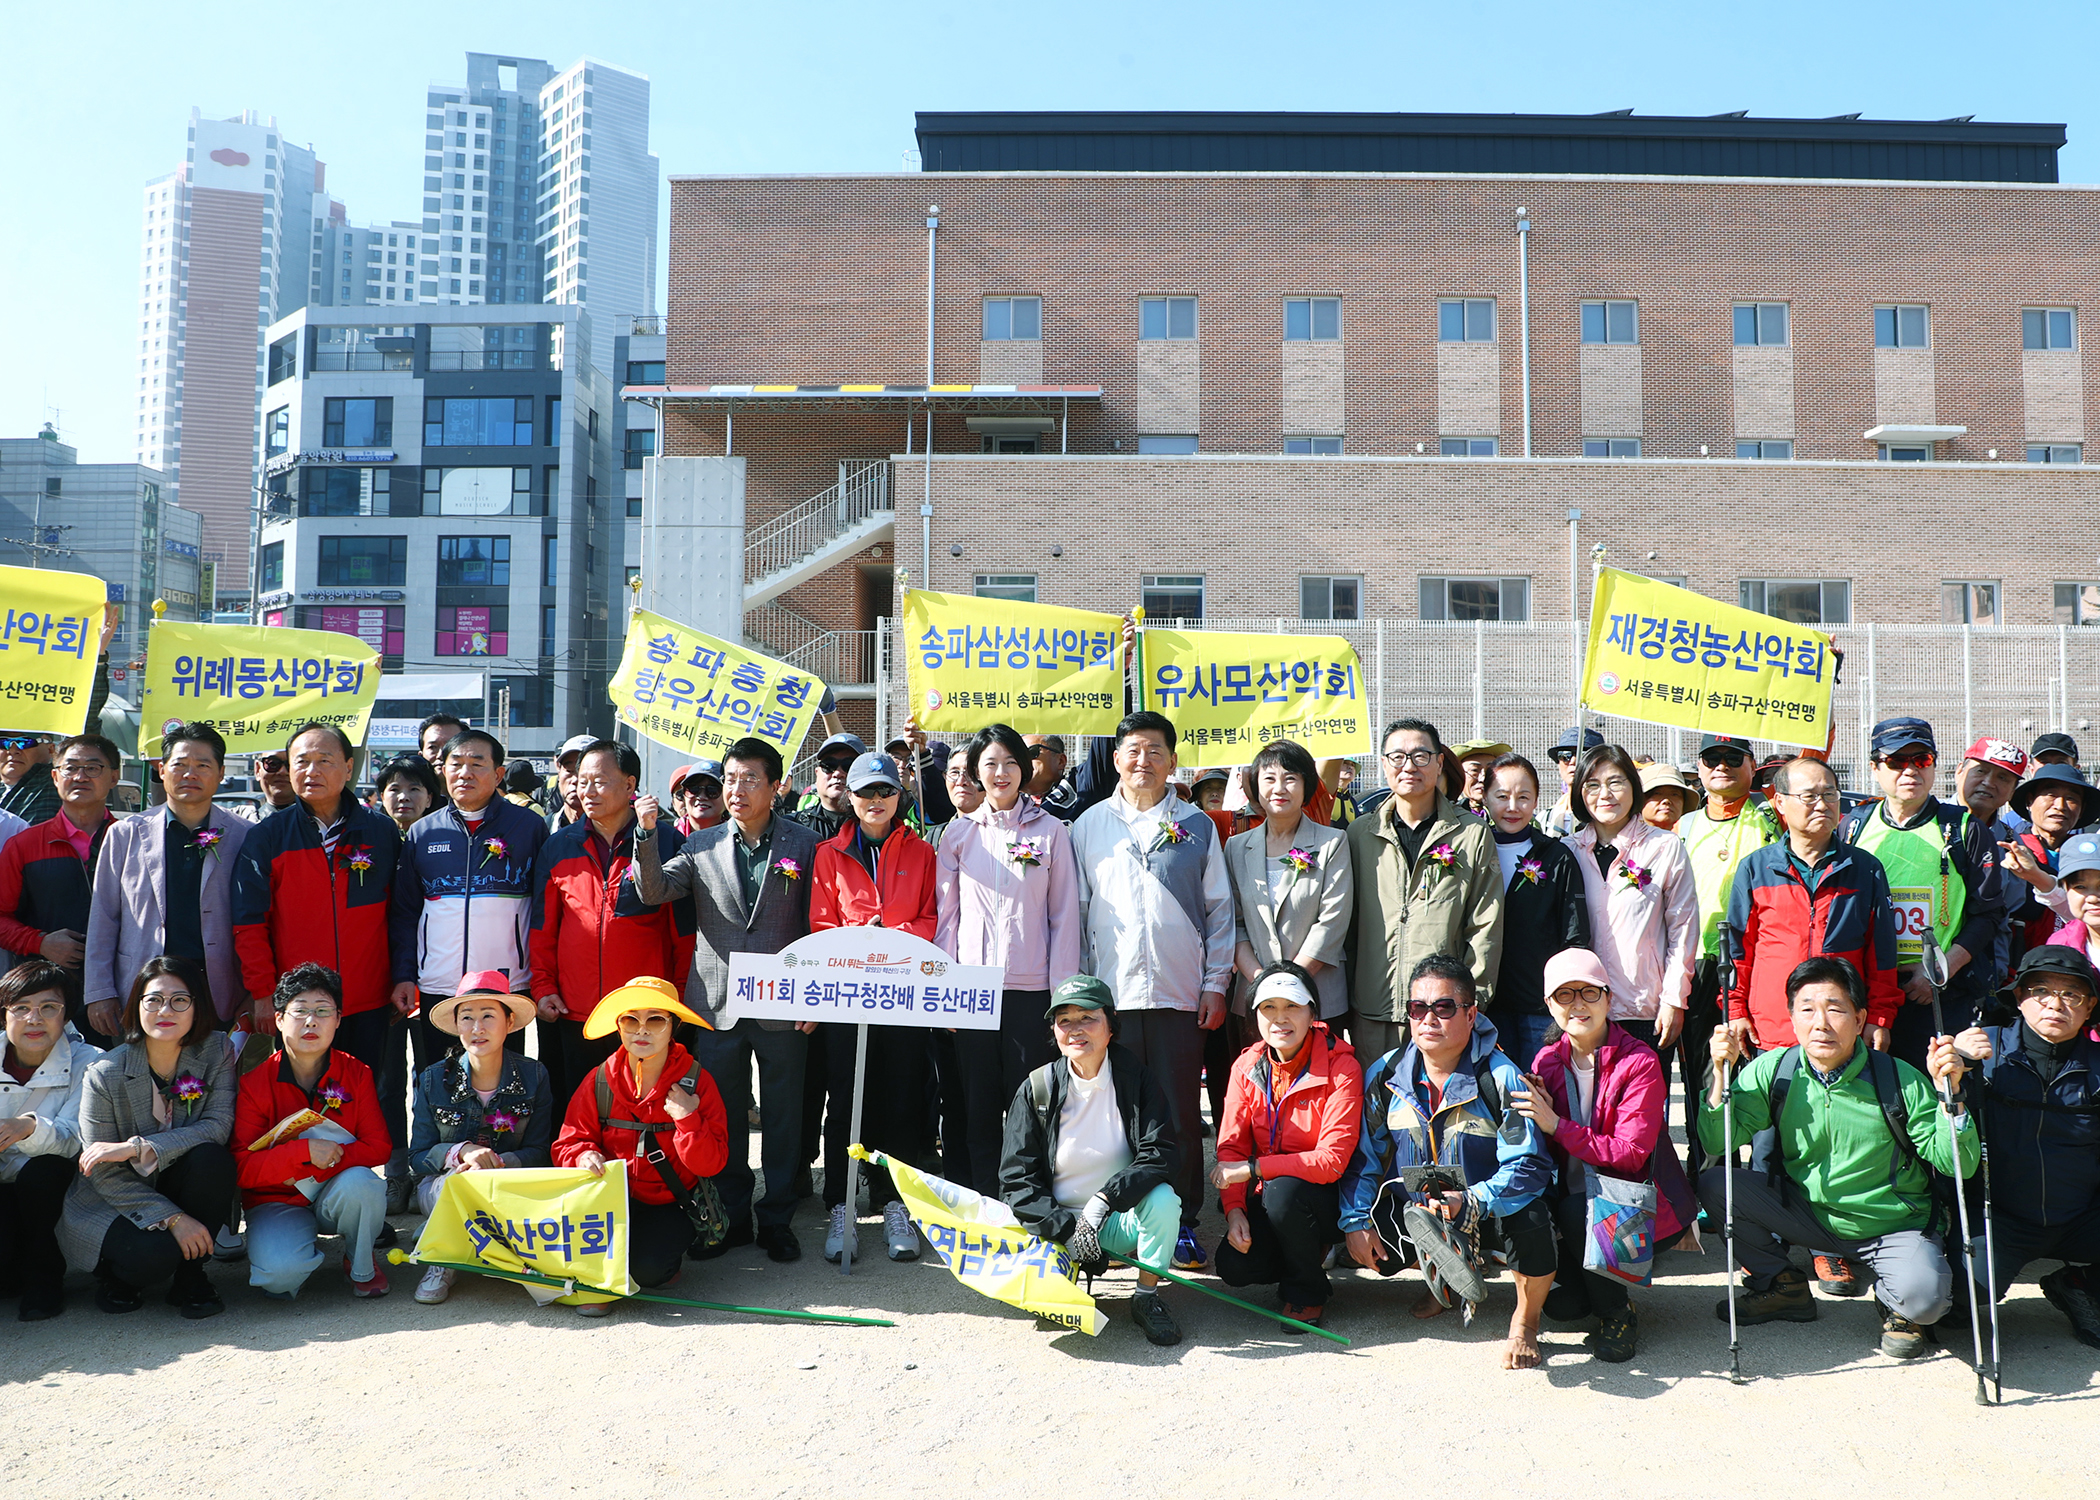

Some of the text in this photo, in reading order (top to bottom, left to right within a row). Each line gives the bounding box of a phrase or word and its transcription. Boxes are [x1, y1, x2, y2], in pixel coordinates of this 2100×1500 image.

[449, 401, 475, 416] 언어
[299, 449, 343, 464] 음악학원
[203, 552, 224, 562] 212
[919, 623, 1115, 672] 송파삼성산악회
[1605, 612, 1824, 684] 재경청농산악회
[172, 654, 365, 700] 위례동산악회
[1154, 659, 1356, 709] 유사모산악회
[633, 665, 798, 746] 향우산악회
[946, 690, 1011, 710] 서울특별시
[1016, 691, 1114, 711] 송파구산악연맹
[1624, 678, 1701, 707] 서울특별시
[1706, 692, 1817, 724] 송파구산악연맹
[640, 711, 696, 741] 서울특별시
[1182, 716, 1357, 747] 서울특별시 송파구산악연맹
[427, 843, 452, 855] SEOUL
[800, 956, 865, 970] 송파구 다시 뛰는
[866, 952, 888, 964] 송파!
[736, 975, 996, 1015] 제11회 송파구청장배 등산대회
[916, 1218, 1076, 1283] 영남산악회
